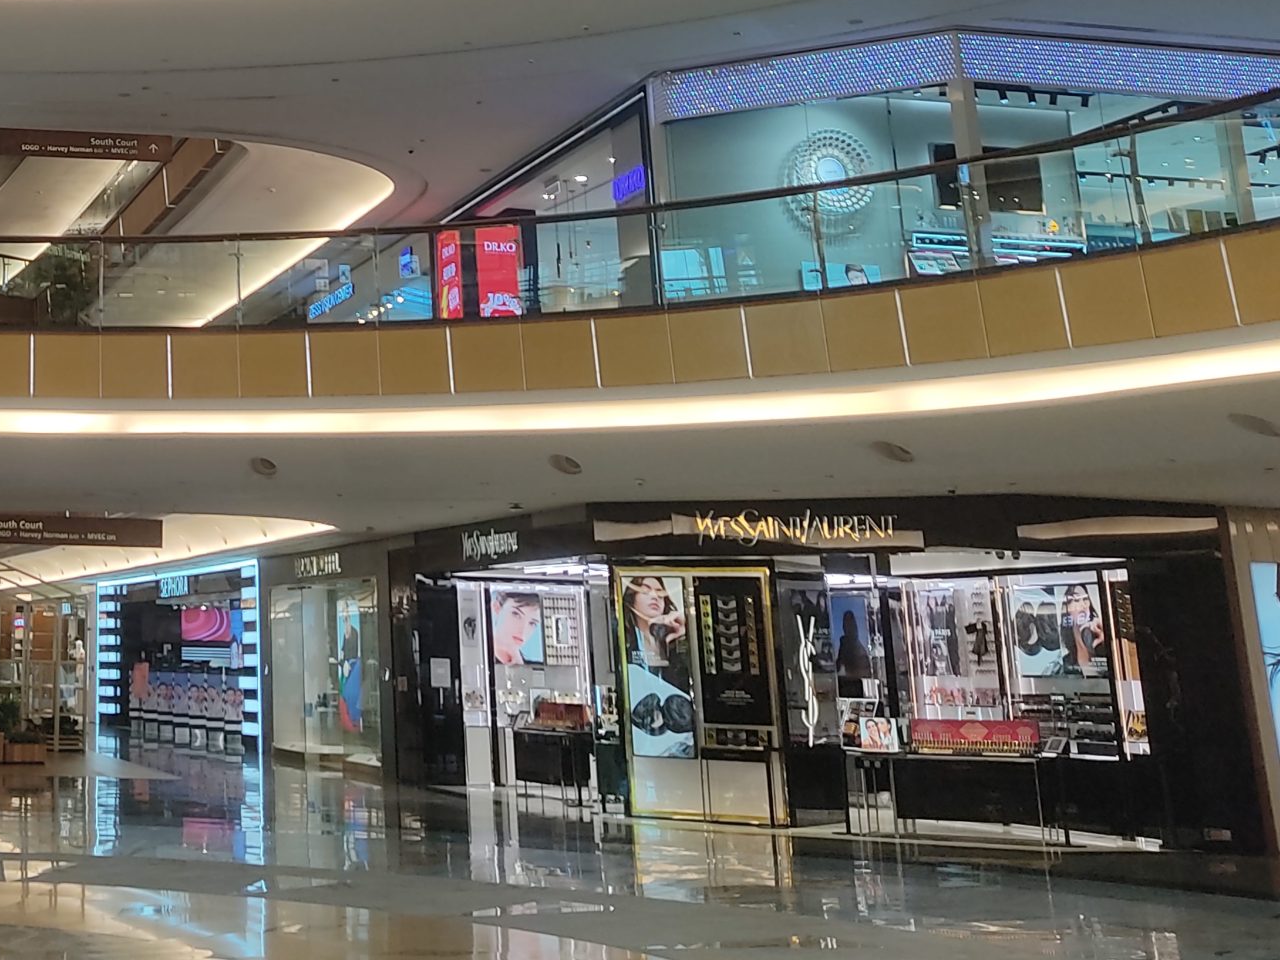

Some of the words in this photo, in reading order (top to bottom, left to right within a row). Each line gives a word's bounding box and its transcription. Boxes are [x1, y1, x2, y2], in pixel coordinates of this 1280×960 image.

[90, 138, 113, 146] South
[116, 139, 137, 147] Court
[47, 145, 68, 153] Harvey
[20, 520, 43, 529] Court
[20, 531, 41, 539] Harvey
[160, 575, 189, 598] SEPHORA
